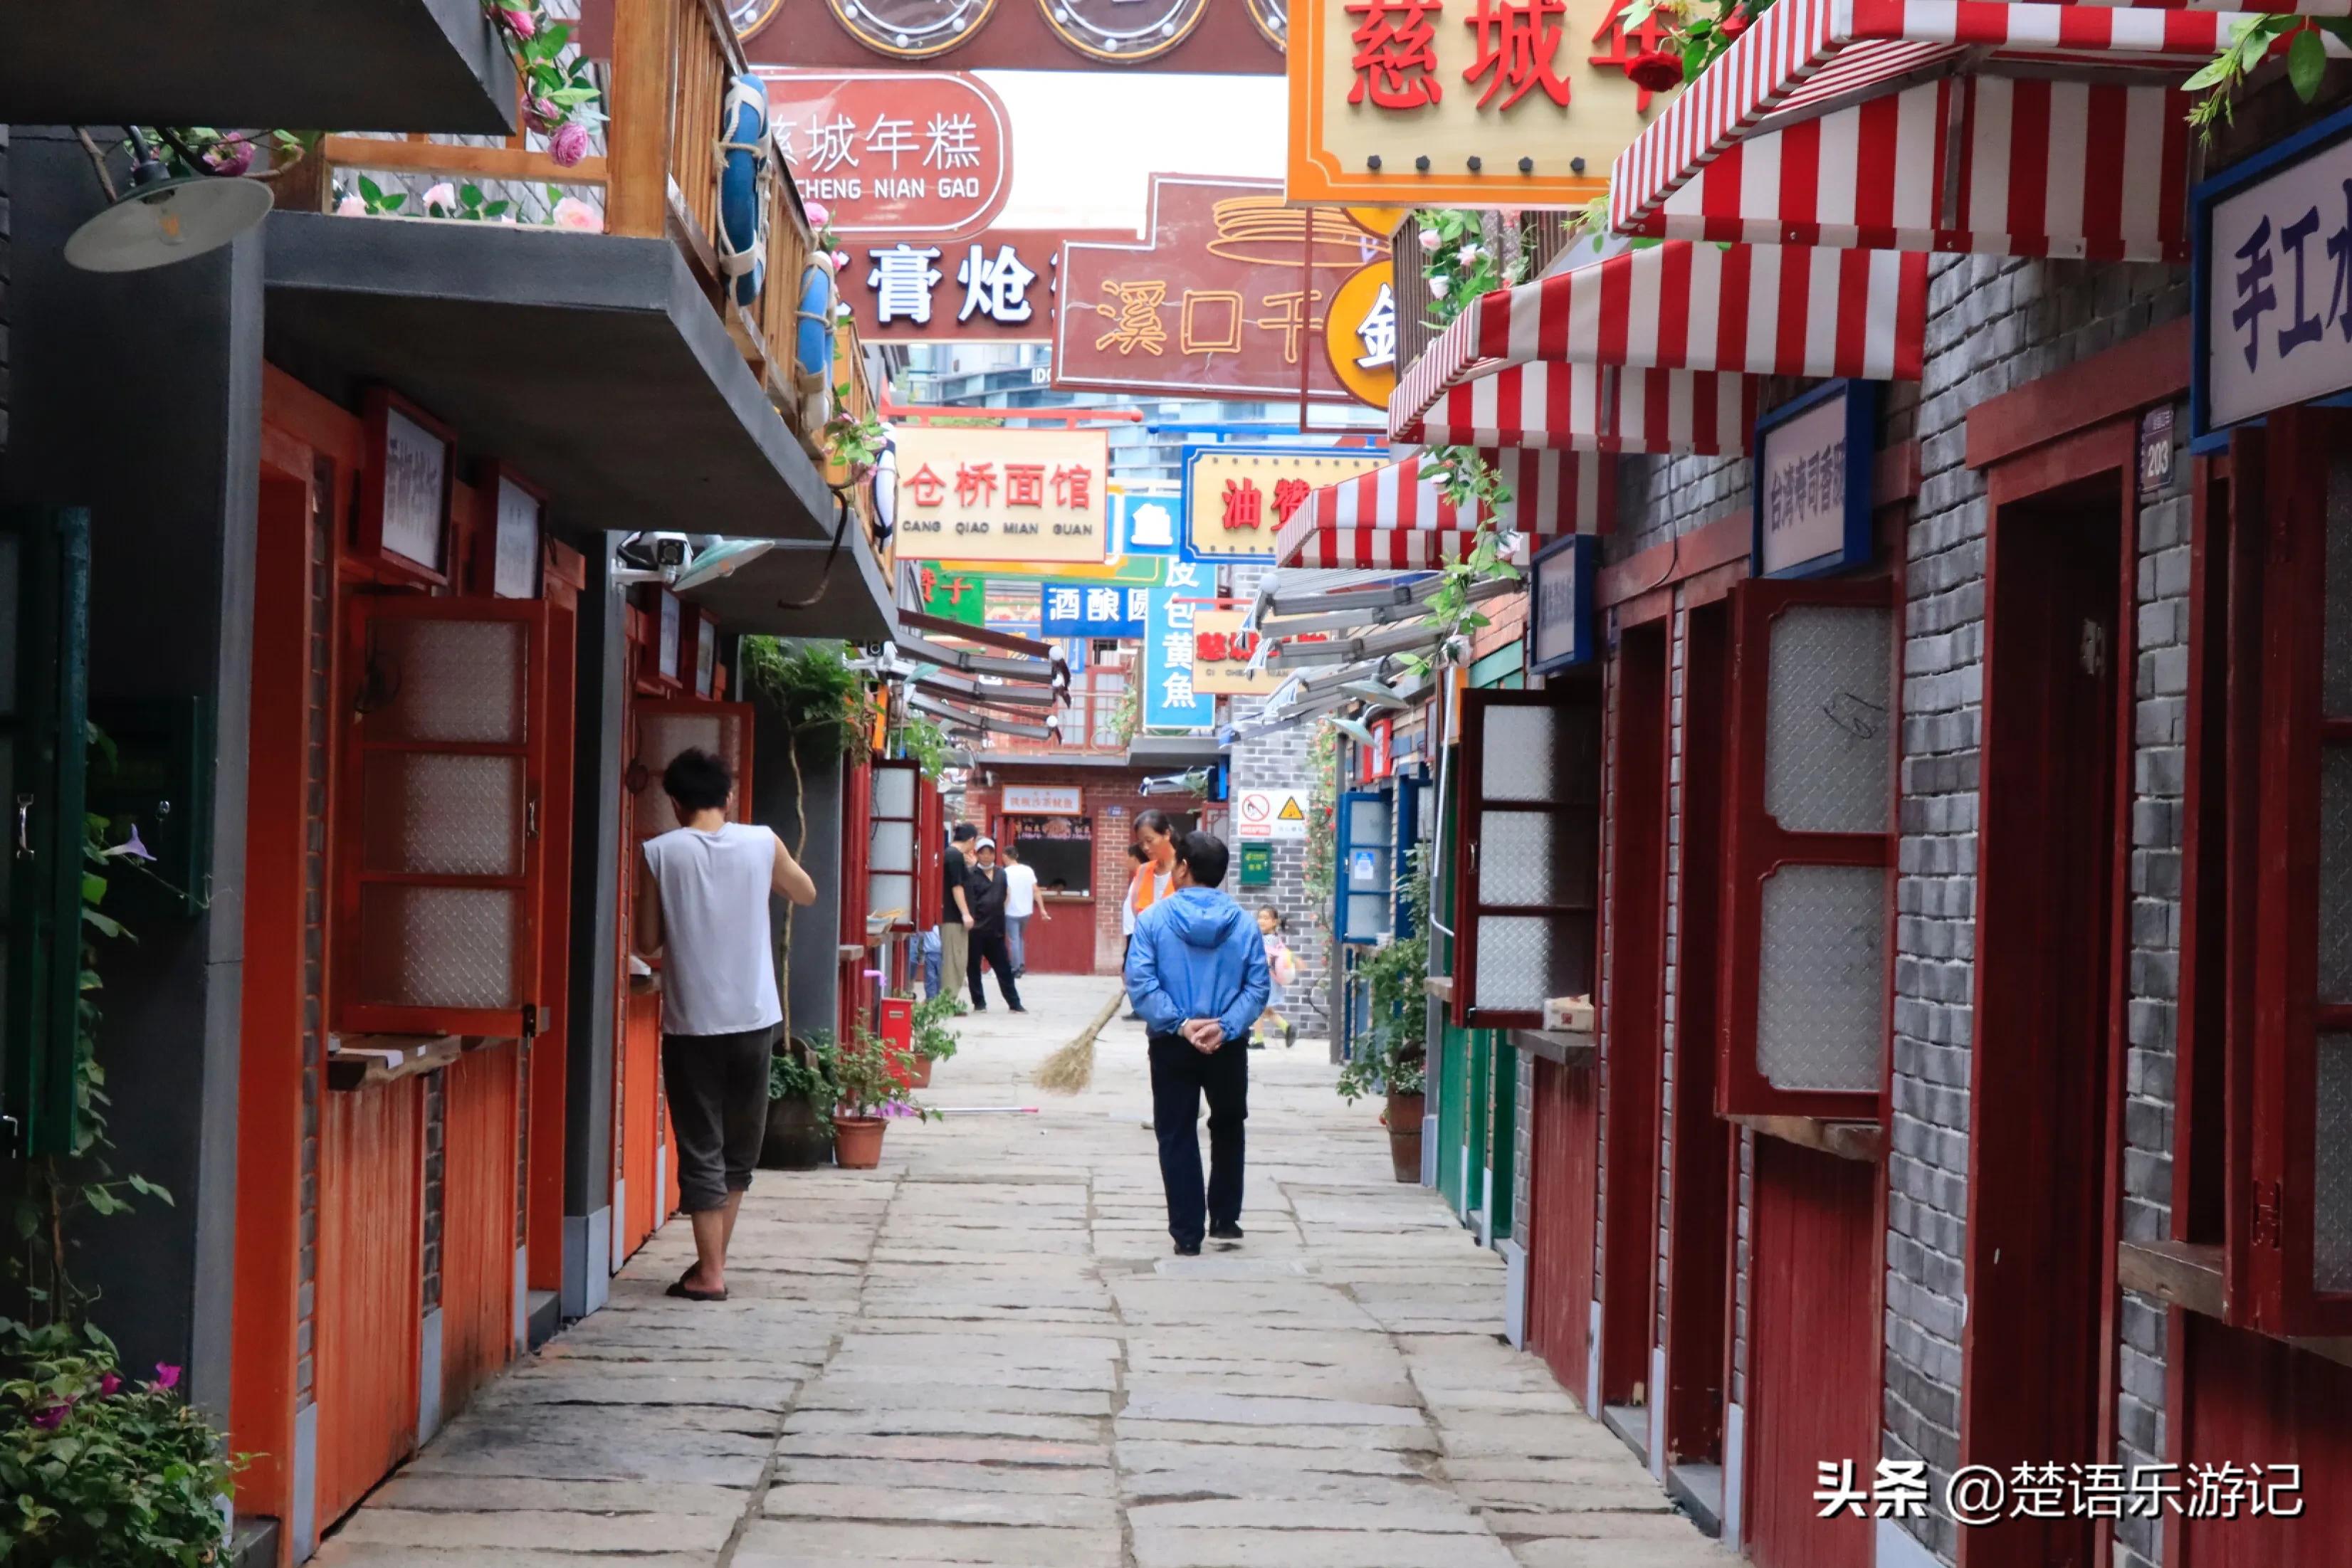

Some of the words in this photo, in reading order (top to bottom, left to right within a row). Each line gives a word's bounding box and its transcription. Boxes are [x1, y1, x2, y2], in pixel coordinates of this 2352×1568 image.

[874, 179, 925, 199] NIAN
[938, 178, 980, 198] GAO
[836, 243, 1057, 325] 膏炝
[903, 462, 1092, 510] 仓桥面馆
[902, 520, 941, 533] CANG
[955, 522, 989, 535] QIAO
[1003, 522, 1039, 535] MIAN
[1053, 523, 1093, 536] GUAN
